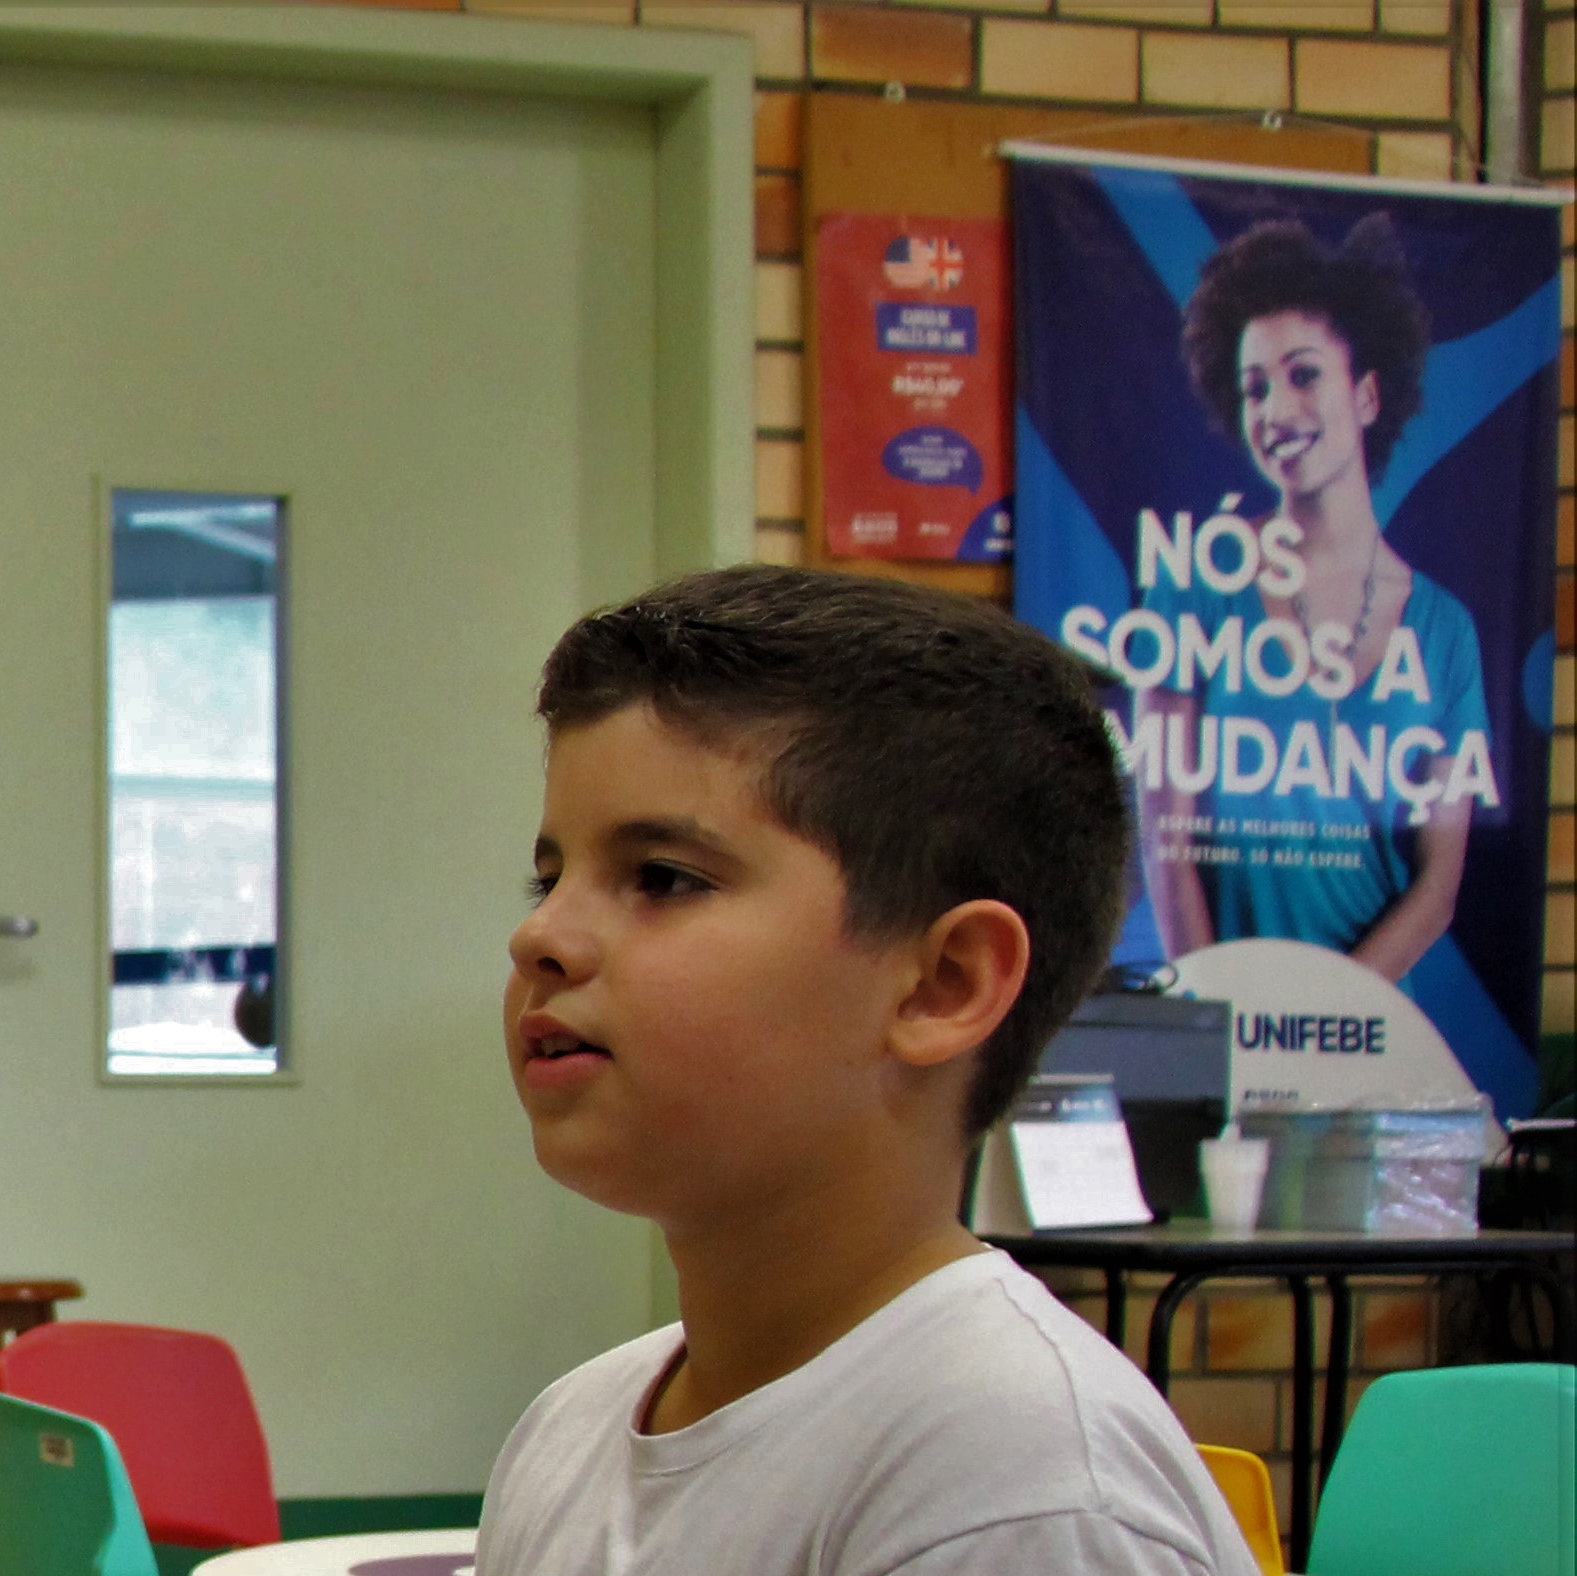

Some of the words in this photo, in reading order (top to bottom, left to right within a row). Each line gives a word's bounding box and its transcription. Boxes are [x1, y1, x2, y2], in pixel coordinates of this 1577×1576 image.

[1137, 493, 1306, 597] NÓS
[1061, 604, 1357, 699] SOMOS
[1372, 625, 1430, 702] A
[1104, 708, 1500, 824] MUDANÇA
[1237, 1014, 1386, 1053] UNIFEBE
